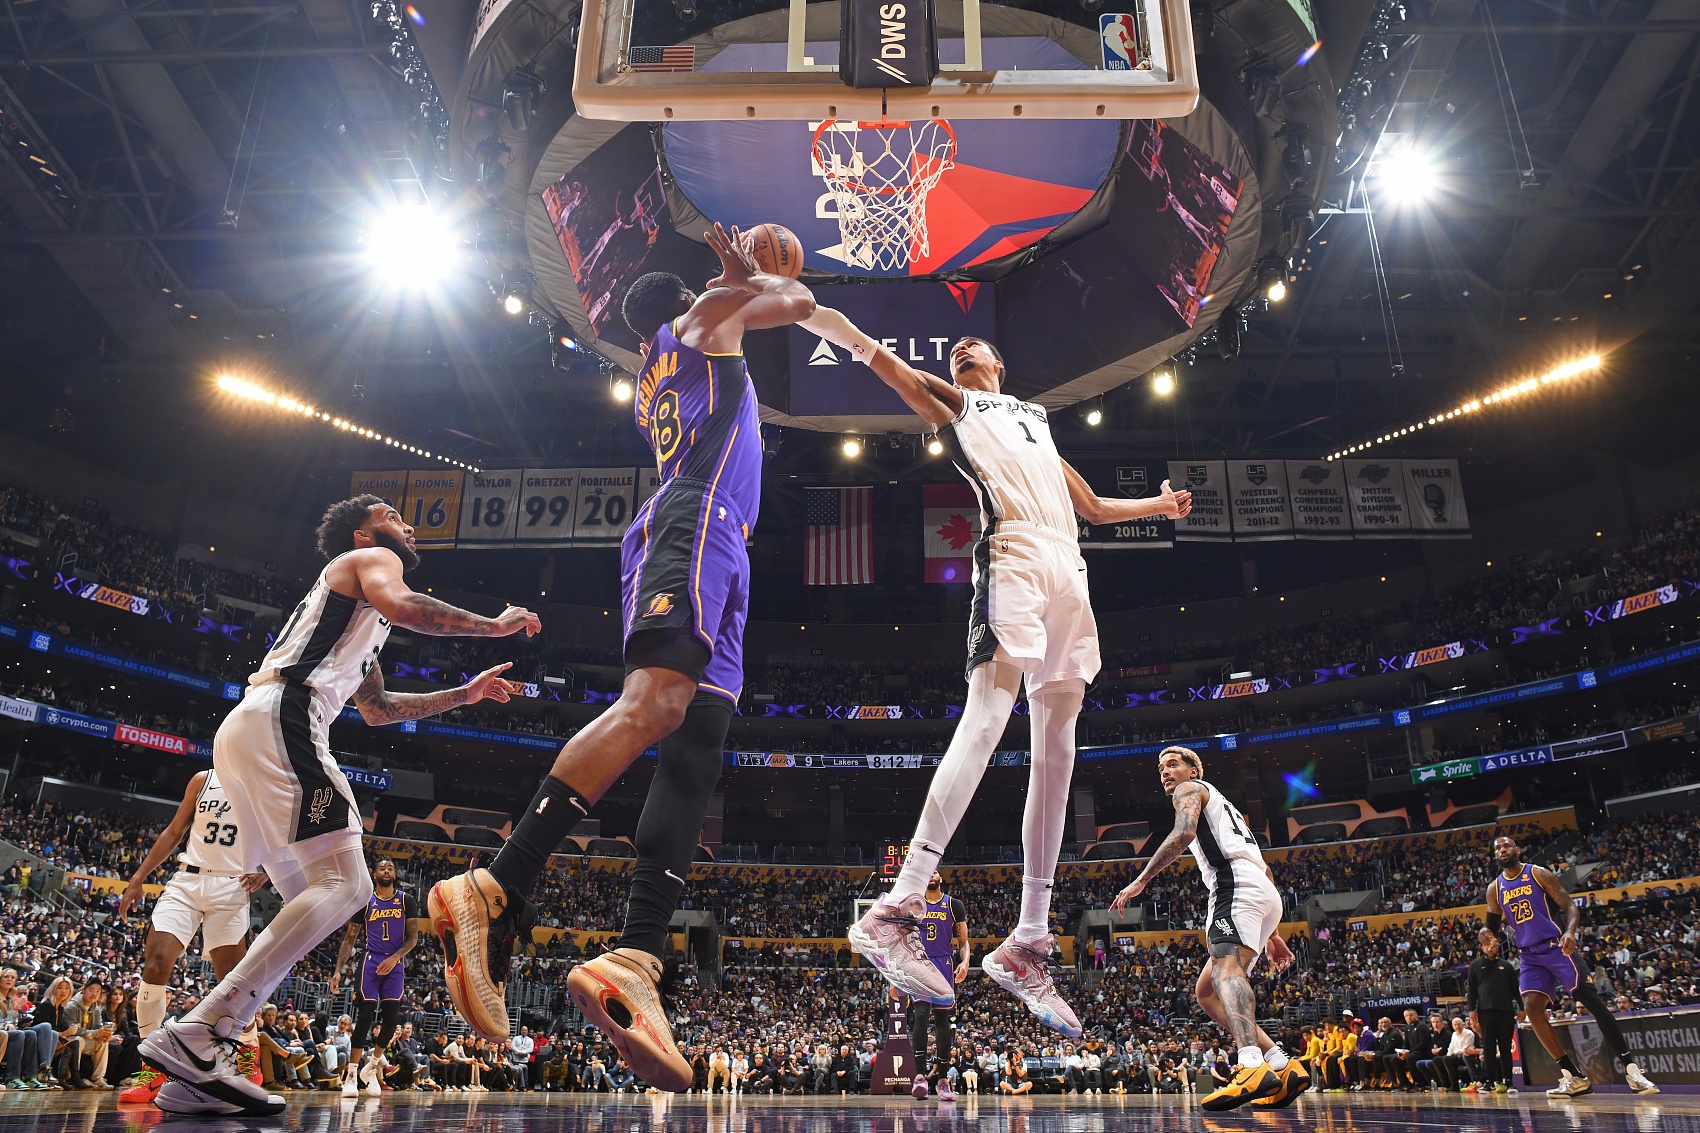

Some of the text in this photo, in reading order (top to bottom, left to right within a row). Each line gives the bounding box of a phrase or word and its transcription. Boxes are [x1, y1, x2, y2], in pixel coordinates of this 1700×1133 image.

[1108, 60, 1126, 70] NBA
[638, 351, 678, 428] HACHIMURA
[1018, 421, 1037, 444] 1
[1119, 470, 1145, 480] LA
[1247, 466, 1266, 474] LA
[1411, 468, 1451, 478] MILLER
[358, 479, 399, 489] VACHON
[415, 478, 455, 488] DIONNE
[526, 477, 574, 487] GRETZKY
[580, 476, 633, 487] ROBITAILLE
[1240, 488, 1278, 497] WESTERN
[1298, 488, 1338, 496] CAMPBELL
[1361, 487, 1392, 495] SMYTHE
[1234, 497, 1286, 506] CONFERENCE
[1294, 496, 1344, 505] CONFERENCE
[1361, 495, 1395, 504] DIVISION
[413, 497, 447, 529] 16
[471, 496, 506, 528] 18
[525, 495, 570, 527] 99
[581, 495, 627, 526] 20
[1238, 505, 1285, 515] CHAMPIONS
[1298, 505, 1344, 513] CHAMPIONS
[1357, 504, 1402, 512] CHAMPIONS
[1187, 517, 1219, 527] 2013-14
[1246, 516, 1280, 527] 2011-12
[1303, 515, 1341, 525] 1992-93
[1363, 515, 1400, 524] 1990-91
[1114, 525, 1159, 538] 2011-12
[82, 583, 149, 616] LAKERS
[1612, 584, 1678, 619] LAKERS
[1405, 641, 1465, 669] LAKERS
[64, 645, 95, 661] LAKERS
[96, 653, 123, 667] GAMES
[123, 659, 139, 671] ARE
[139, 662, 167, 678] BETTER
[1609, 664, 1637, 677] LAKERS
[1212, 678, 1270, 700] LAKERS
[1422, 706, 1449, 717] LAKERS
[1449, 700, 1474, 711] GAMES
[1474, 697, 1488, 706] ARE
[1489, 691, 1516, 703] BETTER
[848, 705, 902, 720] LAKERS
[61, 715, 108, 733] crypto.com
[119, 726, 184, 751] TOSHIBA
[429, 725, 455, 736] LAKERS
[456, 729, 479, 738] GAMES
[493, 733, 518, 743] BETTER
[1249, 734, 1274, 742] LAKERS
[1274, 730, 1297, 739] GAMES
[1298, 728, 1311, 736] ARE
[1083, 751, 1106, 759] LAKERS
[1500, 750, 1547, 767] DELTA
[805, 756, 813, 767] 9
[833, 758, 859, 766] Lakers
[873, 756, 905, 768] 8:12
[913, 759, 919, 768] 1
[1442, 762, 1472, 777] Sprite
[346, 771, 387, 786] DELTA
[204, 822, 238, 847] 33
[950, 868, 990, 878] LOS
[1502, 884, 1533, 906] LAKERS
[369, 908, 402, 922] LAKERS
[1510, 899, 1534, 925] 23
[382, 921, 390, 941] 1
[927, 922, 937, 941] 3
[1352, 921, 1365, 931] 117
[1367, 996, 1421, 1008] 17x CHAMPIONS
[1647, 1054, 1675, 1073] DAY
